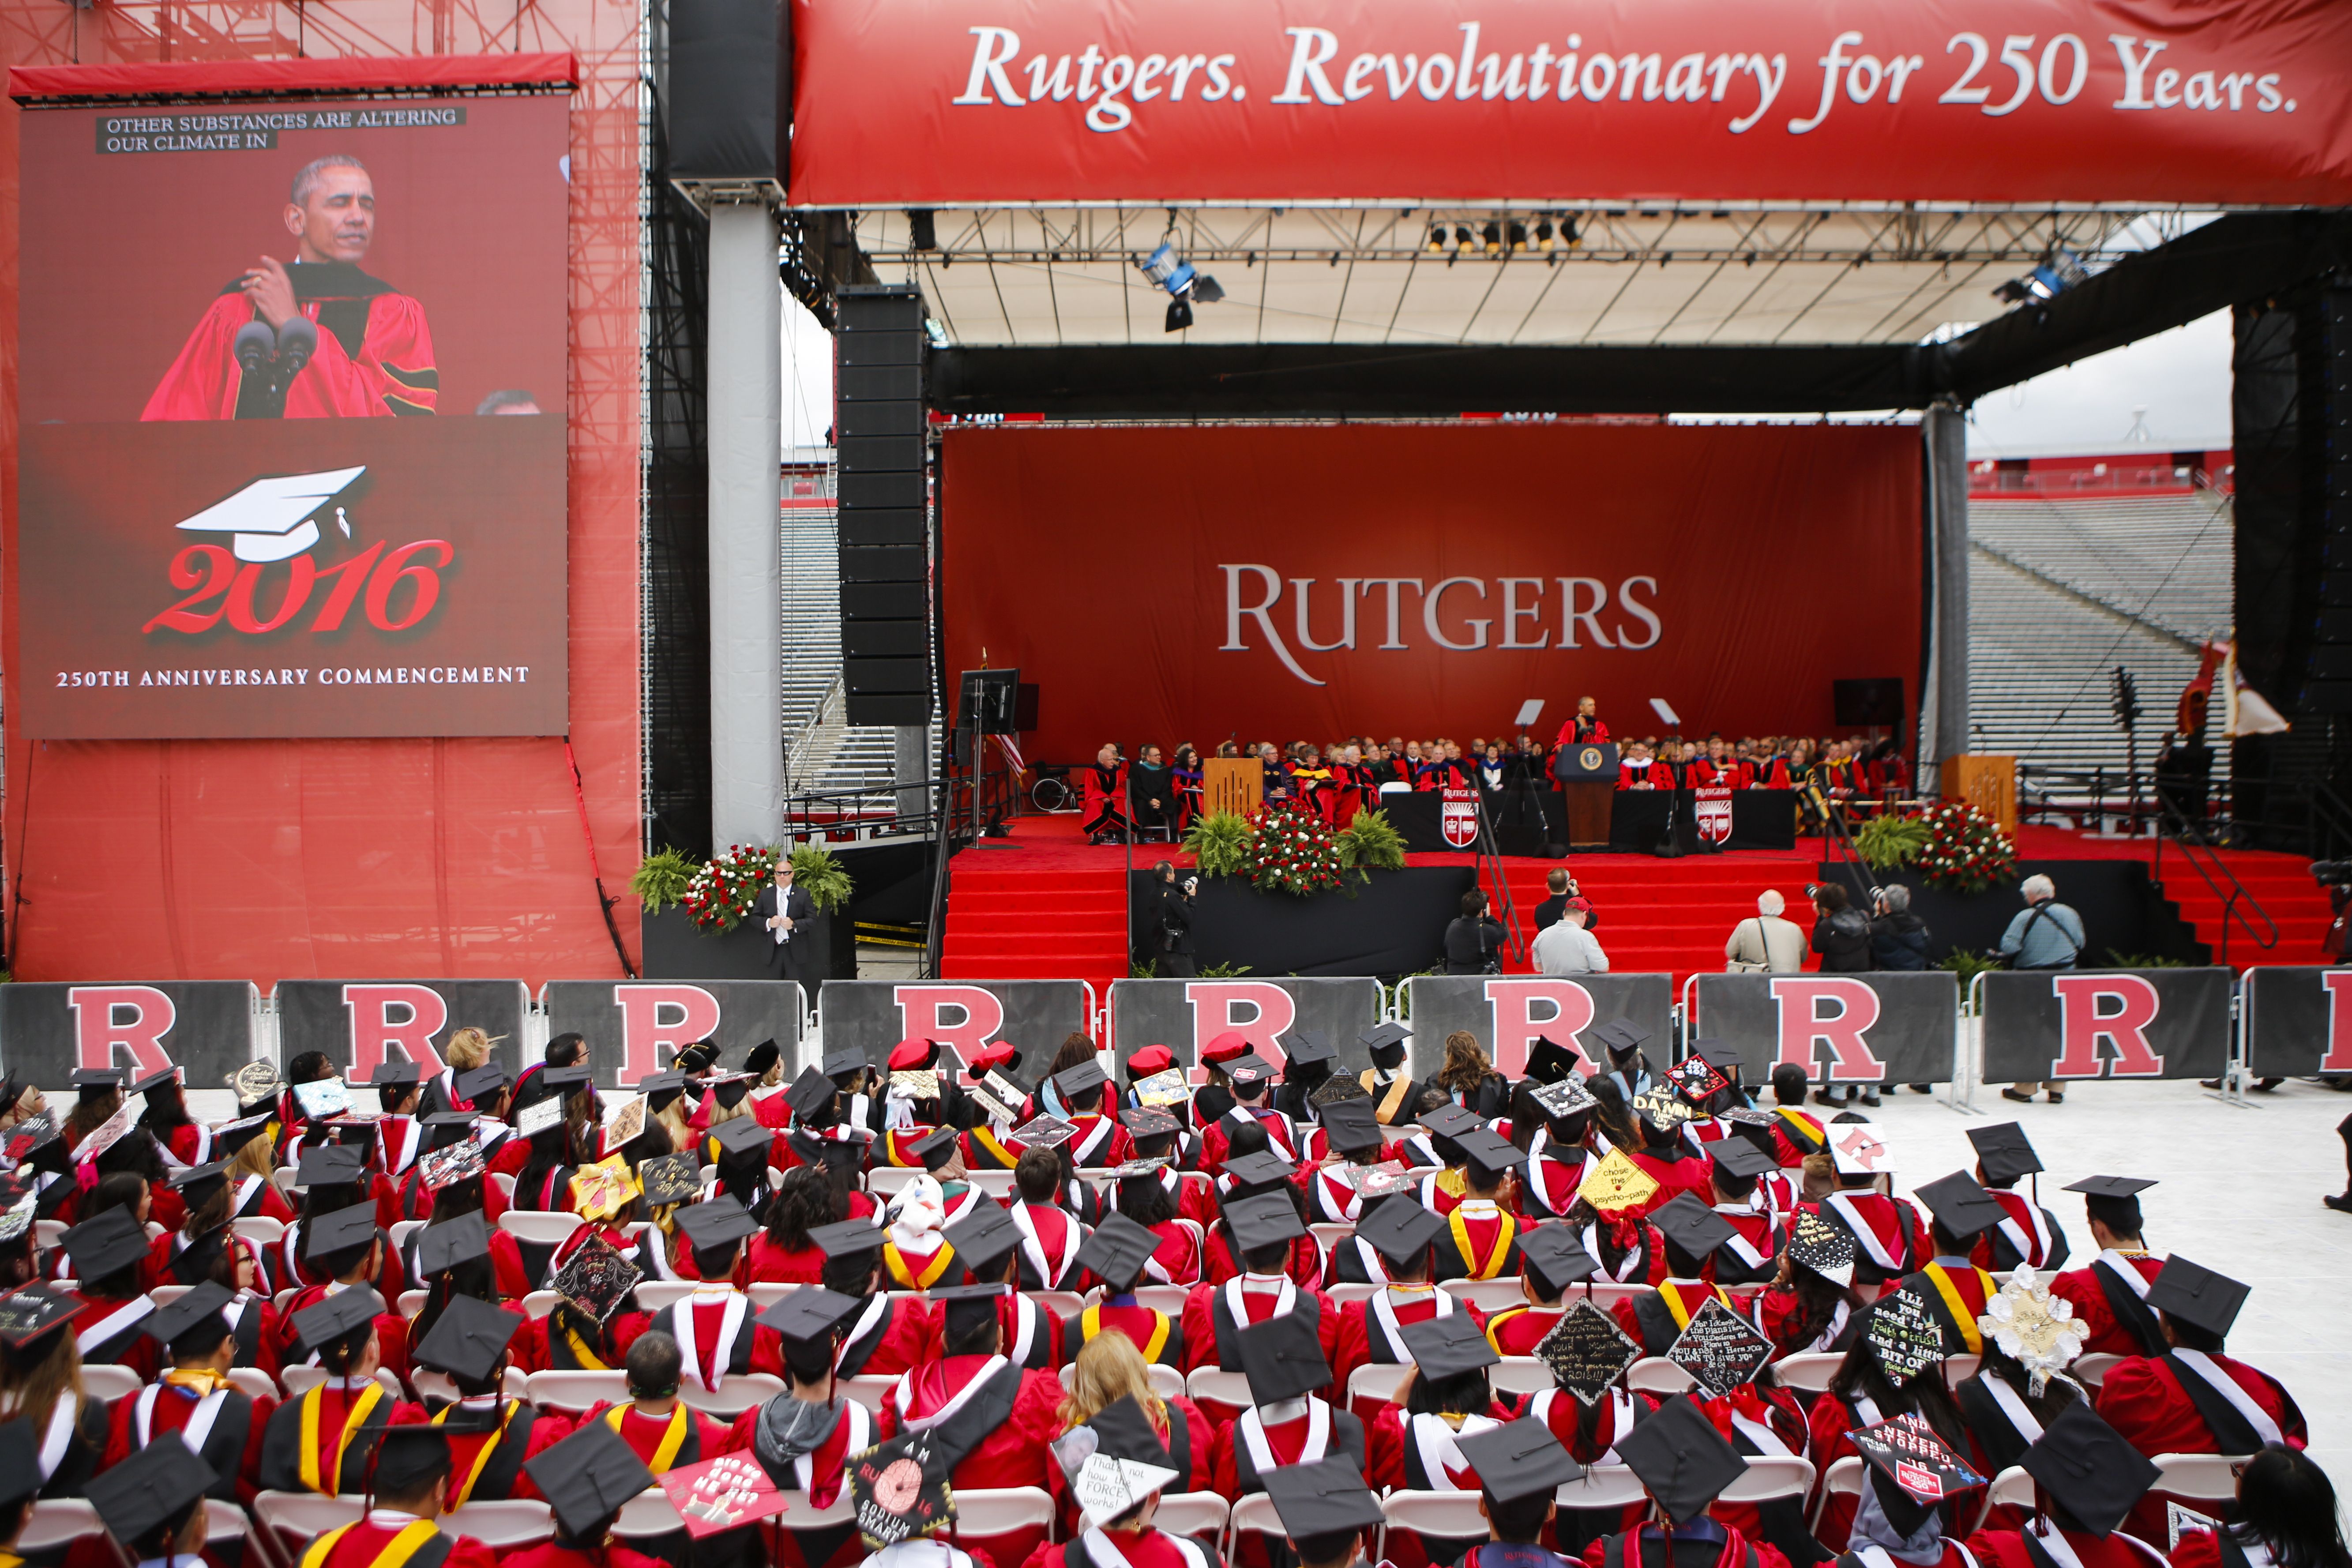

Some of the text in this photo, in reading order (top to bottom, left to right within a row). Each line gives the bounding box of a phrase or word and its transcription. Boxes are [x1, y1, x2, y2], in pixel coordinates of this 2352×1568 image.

[952, 21, 2297, 134] Rutgers. Revolutionary for 250 Years.
[107, 109, 456, 133] OTHER SUBSTANCES ARE ALTERING
[107, 133, 269, 152] OUR CLIMATE IN
[142, 539, 454, 634] 2016
[1218, 563, 1663, 686] RUTGERS
[56, 666, 530, 687] 250TH ANNIVERSARY COMMENCEMENT
[68, 985, 186, 1087] R
[341, 984, 448, 1087] R
[614, 984, 727, 1089] R
[894, 984, 1004, 1089] R
[1184, 981, 1296, 1087] R
[1484, 978, 1601, 1084] R
[1768, 976, 1886, 1082] R
[2051, 974, 2164, 1079] R
[990, 1075, 1001, 1085] 2016
[1633, 1095, 1692, 1119] DAMN
[425, 1149, 440, 1160] DAY
[455, 1138, 469, 1147] DAY
[655, 1169, 666, 1179] to
[667, 1157, 690, 1178] Turn
[1603, 1167, 1629, 1177] chose
[1611, 1177, 1626, 1185] the
[1594, 1189, 1649, 1205] psycho-path
[1896, 1288, 1924, 1307] ALL
[1874, 1306, 1924, 1330] need is
[1898, 1303, 1920, 1318] you
[1694, 1320, 1708, 1328] For
[1872, 1318, 1897, 1339] Faith
[1551, 1342, 1574, 1351] YOUR
[1868, 1332, 1944, 1361] and a little
[1880, 1347, 1926, 1370] BIT OF
[1897, 1414, 1928, 1431] AND
[1910, 1425, 1916, 1435] I
[1874, 1429, 1950, 1463] STOPPED
[1884, 1425, 1939, 1452] NEVER
[709, 1466, 753, 1487] done
[714, 1457, 762, 1478] are we
[860, 1462, 883, 1481] RU
[1093, 1455, 1144, 1478] That's not
[1087, 1468, 1131, 1487] how the
[1901, 1470, 1937, 1487] RUTGERS
[1909, 1480, 1929, 1489] 250
[1086, 1481, 1124, 1498] FORCE
[918, 1498, 934, 1514] 16
[1084, 1496, 1119, 1509] works!
[862, 1499, 911, 1532] SODIUM
[859, 1512, 899, 1542] SMART
